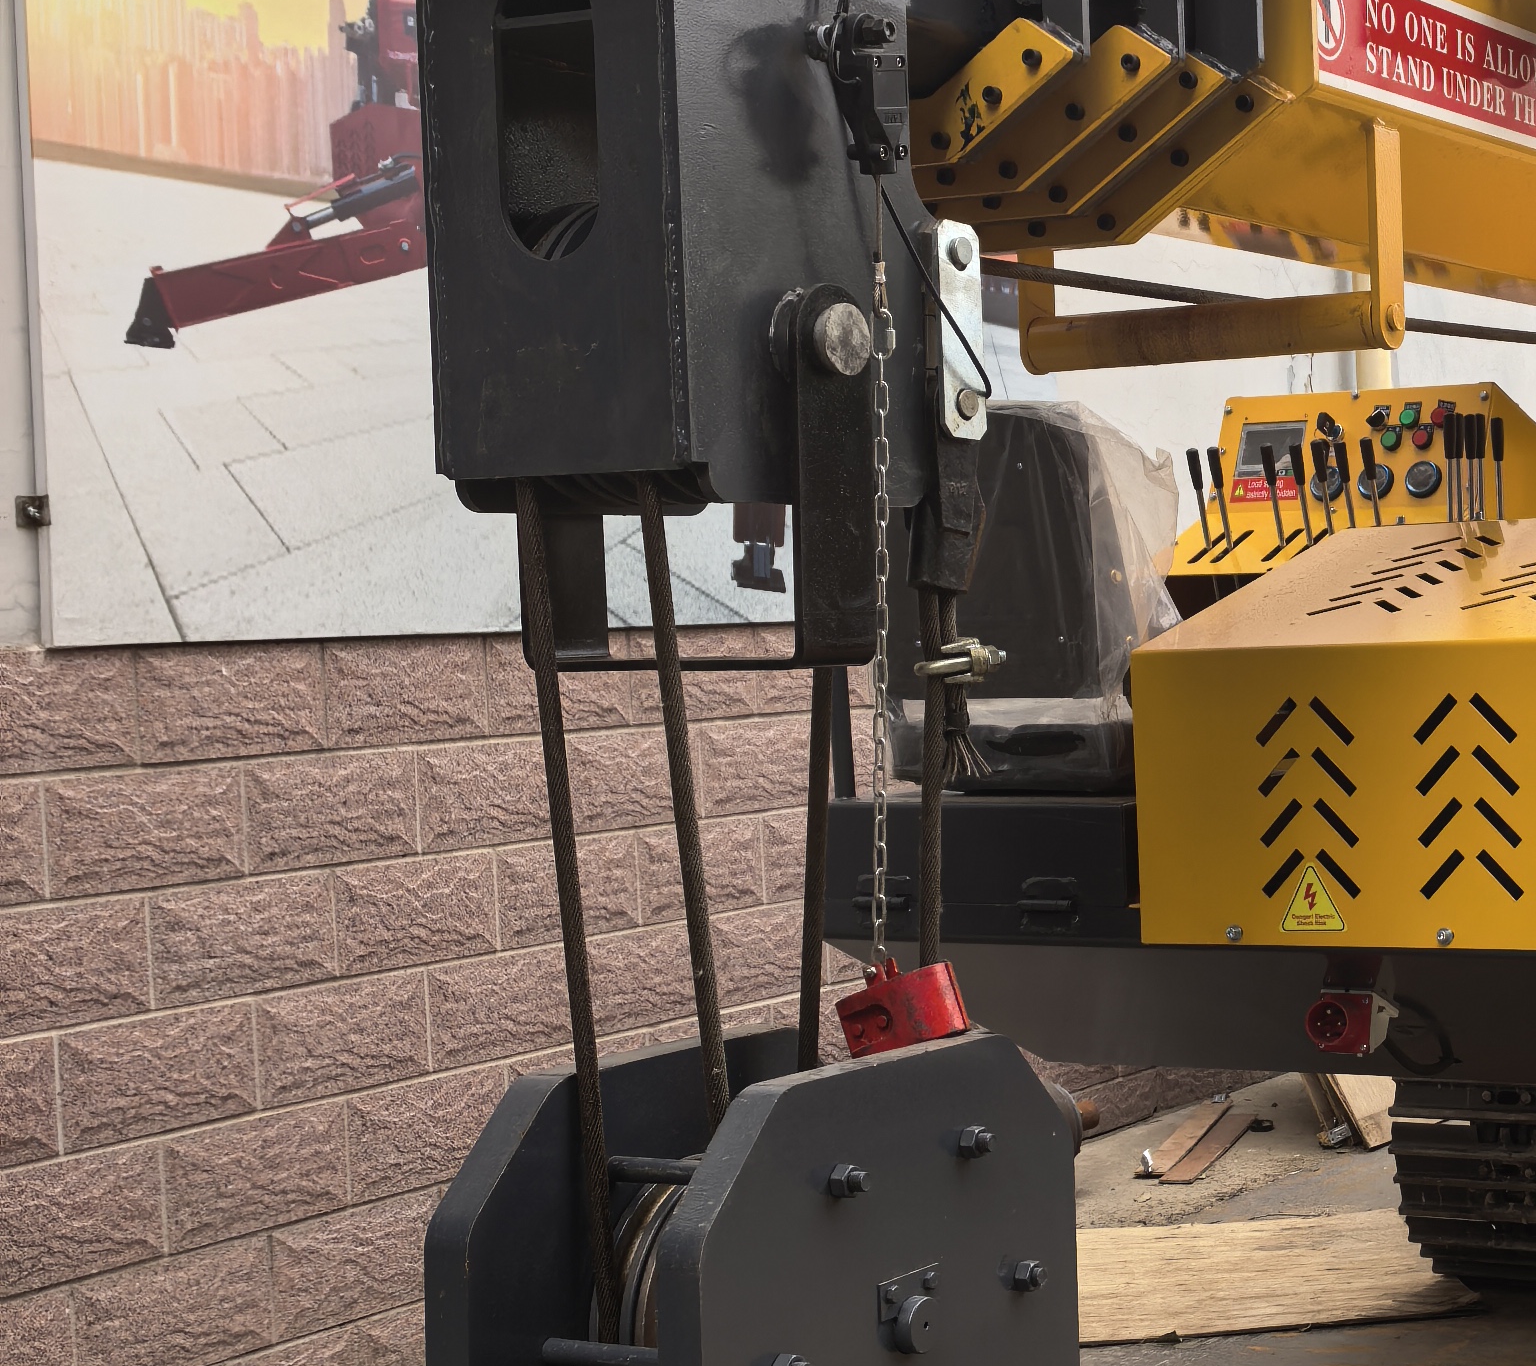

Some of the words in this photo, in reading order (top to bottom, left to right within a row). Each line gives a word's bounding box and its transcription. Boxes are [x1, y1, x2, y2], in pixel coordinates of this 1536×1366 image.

[1404, 11, 1448, 54] ONE
[1456, 29, 1475, 63] IS
[1366, 41, 1435, 92] STAND
[1442, 66, 1506, 117] UNDER
